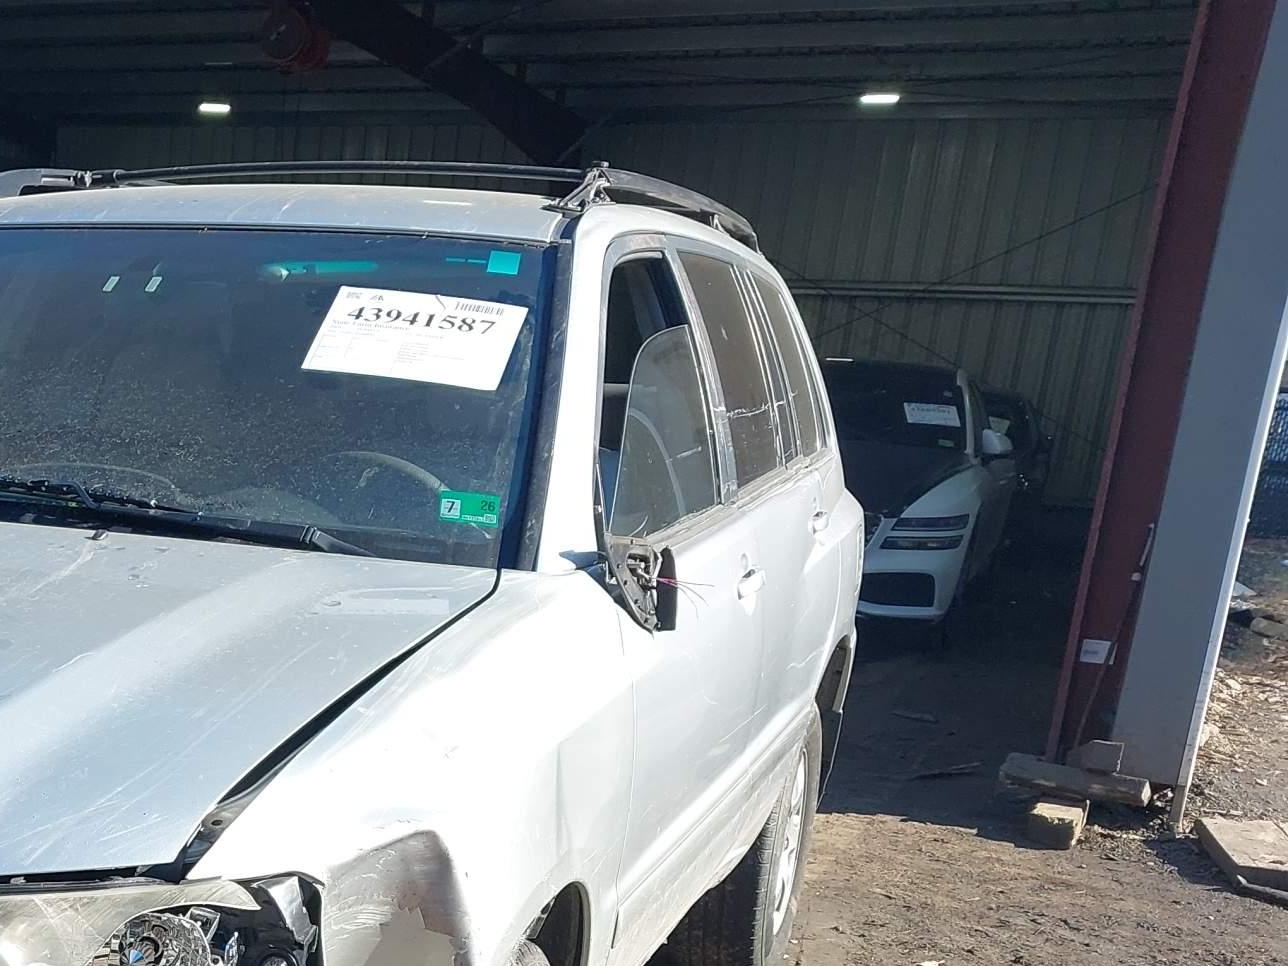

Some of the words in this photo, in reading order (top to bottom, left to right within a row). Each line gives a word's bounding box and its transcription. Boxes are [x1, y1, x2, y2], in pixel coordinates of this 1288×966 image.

[347, 306, 497, 335] 43941587
[446, 500, 456, 513] 7
[480, 500, 496, 512] 26
